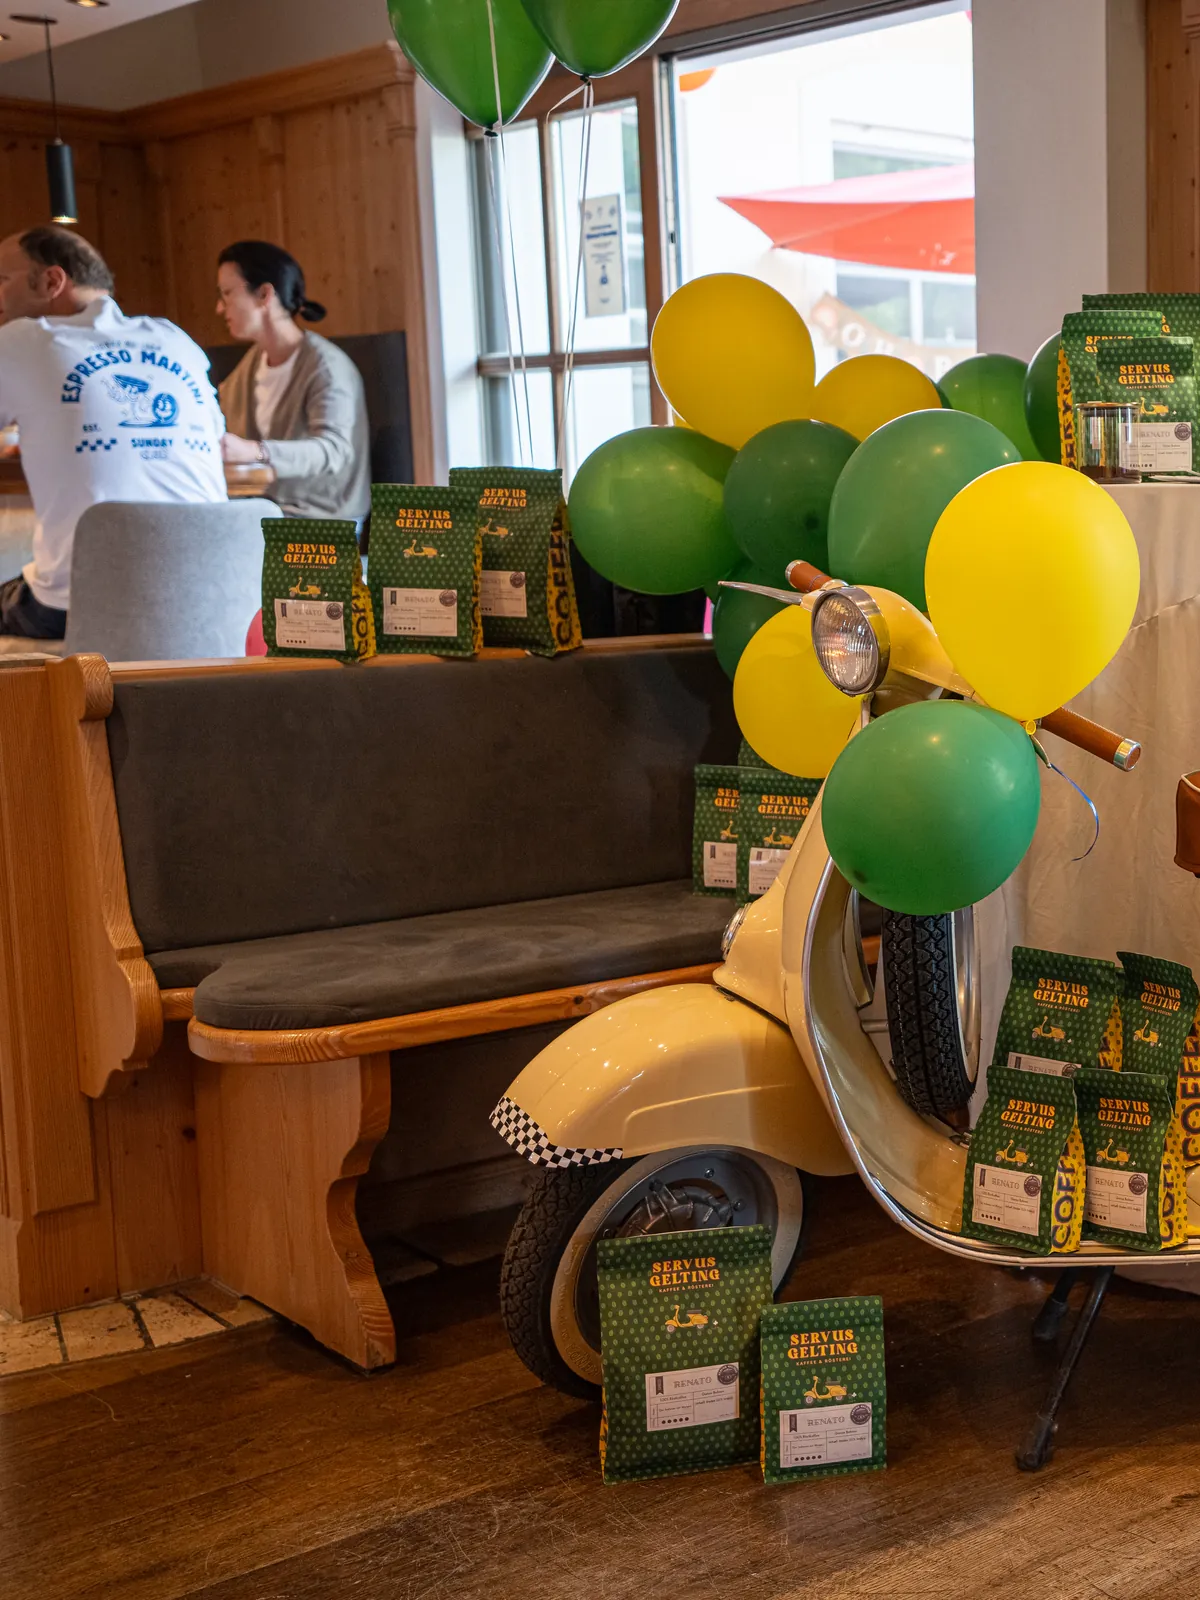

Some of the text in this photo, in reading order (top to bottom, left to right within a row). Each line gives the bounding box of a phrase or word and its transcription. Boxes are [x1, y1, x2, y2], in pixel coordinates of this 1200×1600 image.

[1120, 364, 1170, 374] SERVUS
[61, 350, 204, 405] ESPRESSO MARTINI
[1118, 374, 1174, 384] GELTING
[131, 437, 173, 448] SUNDAY
[484, 489, 526, 497] SERVUS
[480, 498, 526, 507] GELTING
[399, 509, 450, 519] SERVUS
[396, 519, 452, 529] GELTING
[287, 544, 336, 554] SERVUS
[284, 554, 337, 564] GELTING
[761, 794, 808, 806] SERVUS
[758, 804, 810, 816] GELTING
[1038, 977, 1089, 996] SERVUS
[1143, 981, 1181, 999] SERVUS
[1033, 989, 1089, 1008] GELTING
[1140, 991, 1181, 1011] GELTING
[1008, 1099, 1055, 1117] SERVUS
[1099, 1097, 1150, 1113] SERVUS
[1001, 1111, 1055, 1129] GELTING
[1098, 1110, 1151, 1126] GELTING
[991, 1178, 1020, 1189] RENATO
[1095, 1177, 1125, 1189] RENATO
[652, 1257, 716, 1273] SERVUS
[650, 1269, 720, 1287] GELTING
[790, 1329, 854, 1346] SERVUS
[787, 1342, 858, 1359] GELTING
[673, 1376, 712, 1388] RENATO
[807, 1415, 845, 1427] RENATO
